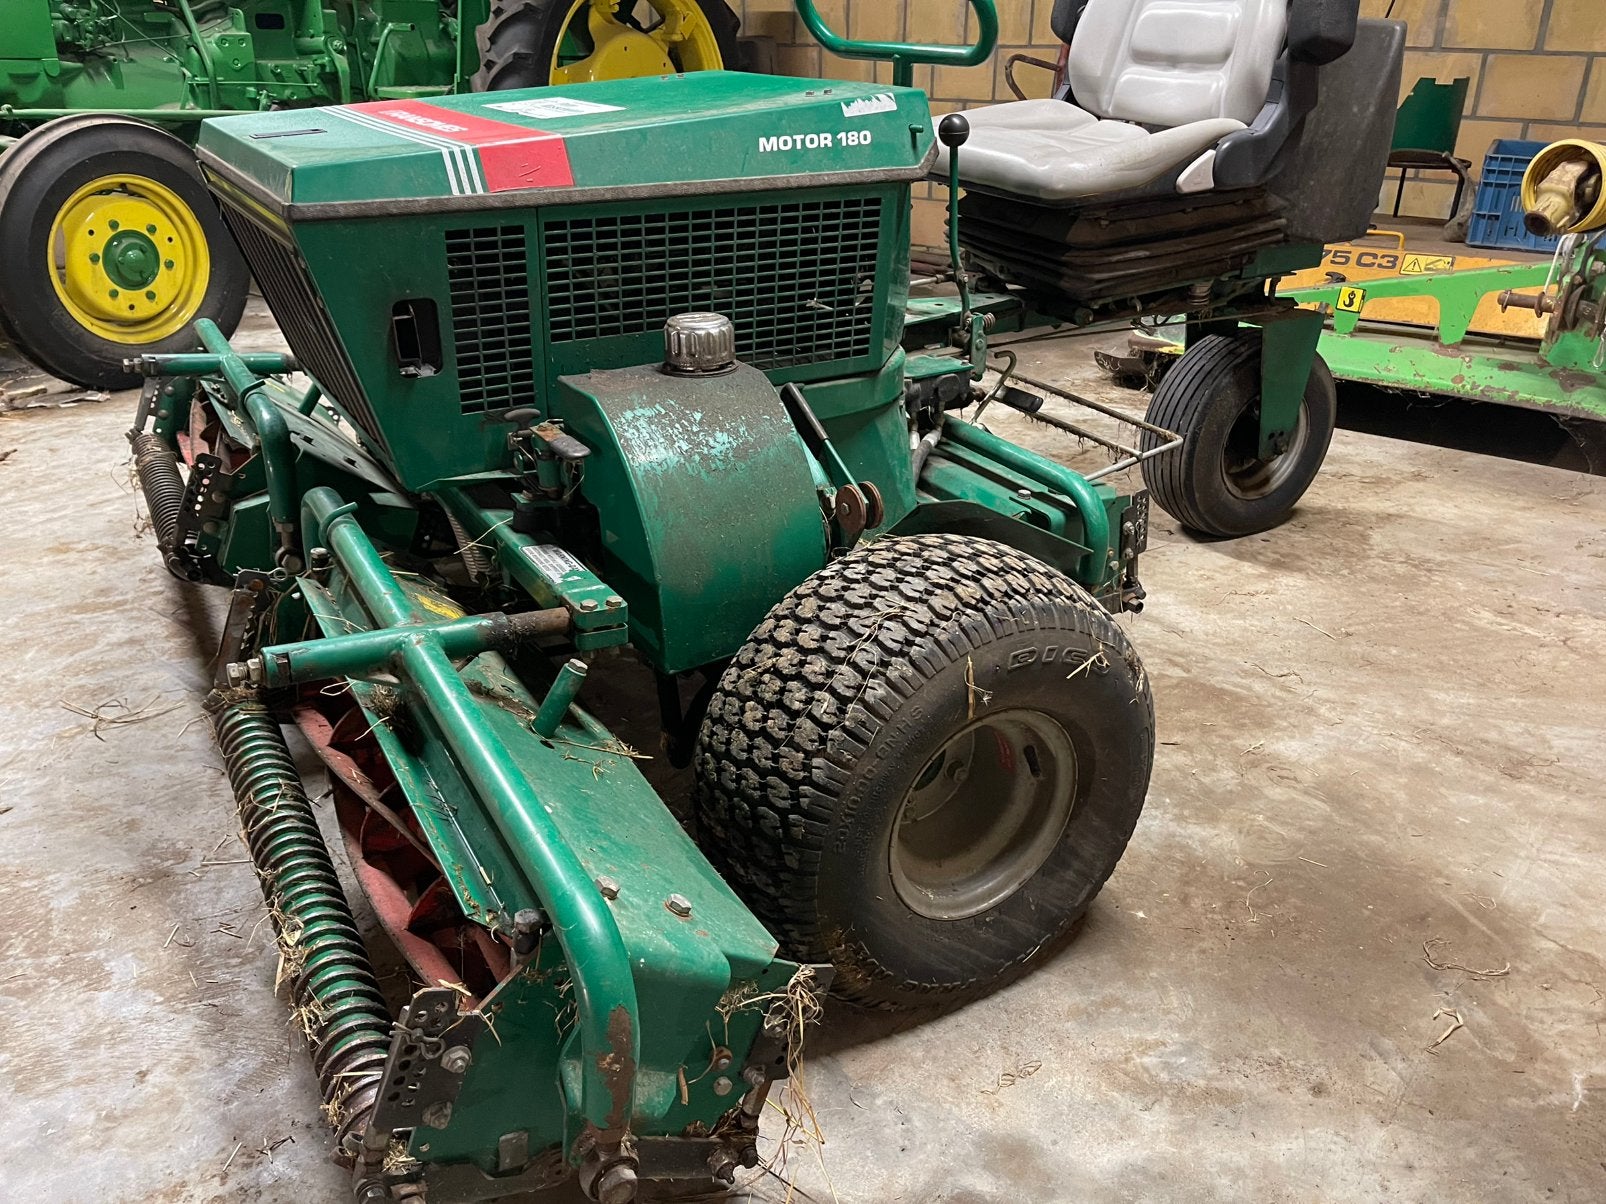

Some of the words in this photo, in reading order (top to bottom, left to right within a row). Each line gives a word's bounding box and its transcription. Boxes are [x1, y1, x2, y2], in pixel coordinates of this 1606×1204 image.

[758, 133, 832, 153] MOTOR
[836, 130, 872, 147] 180
[1355, 252, 1399, 270] C3
